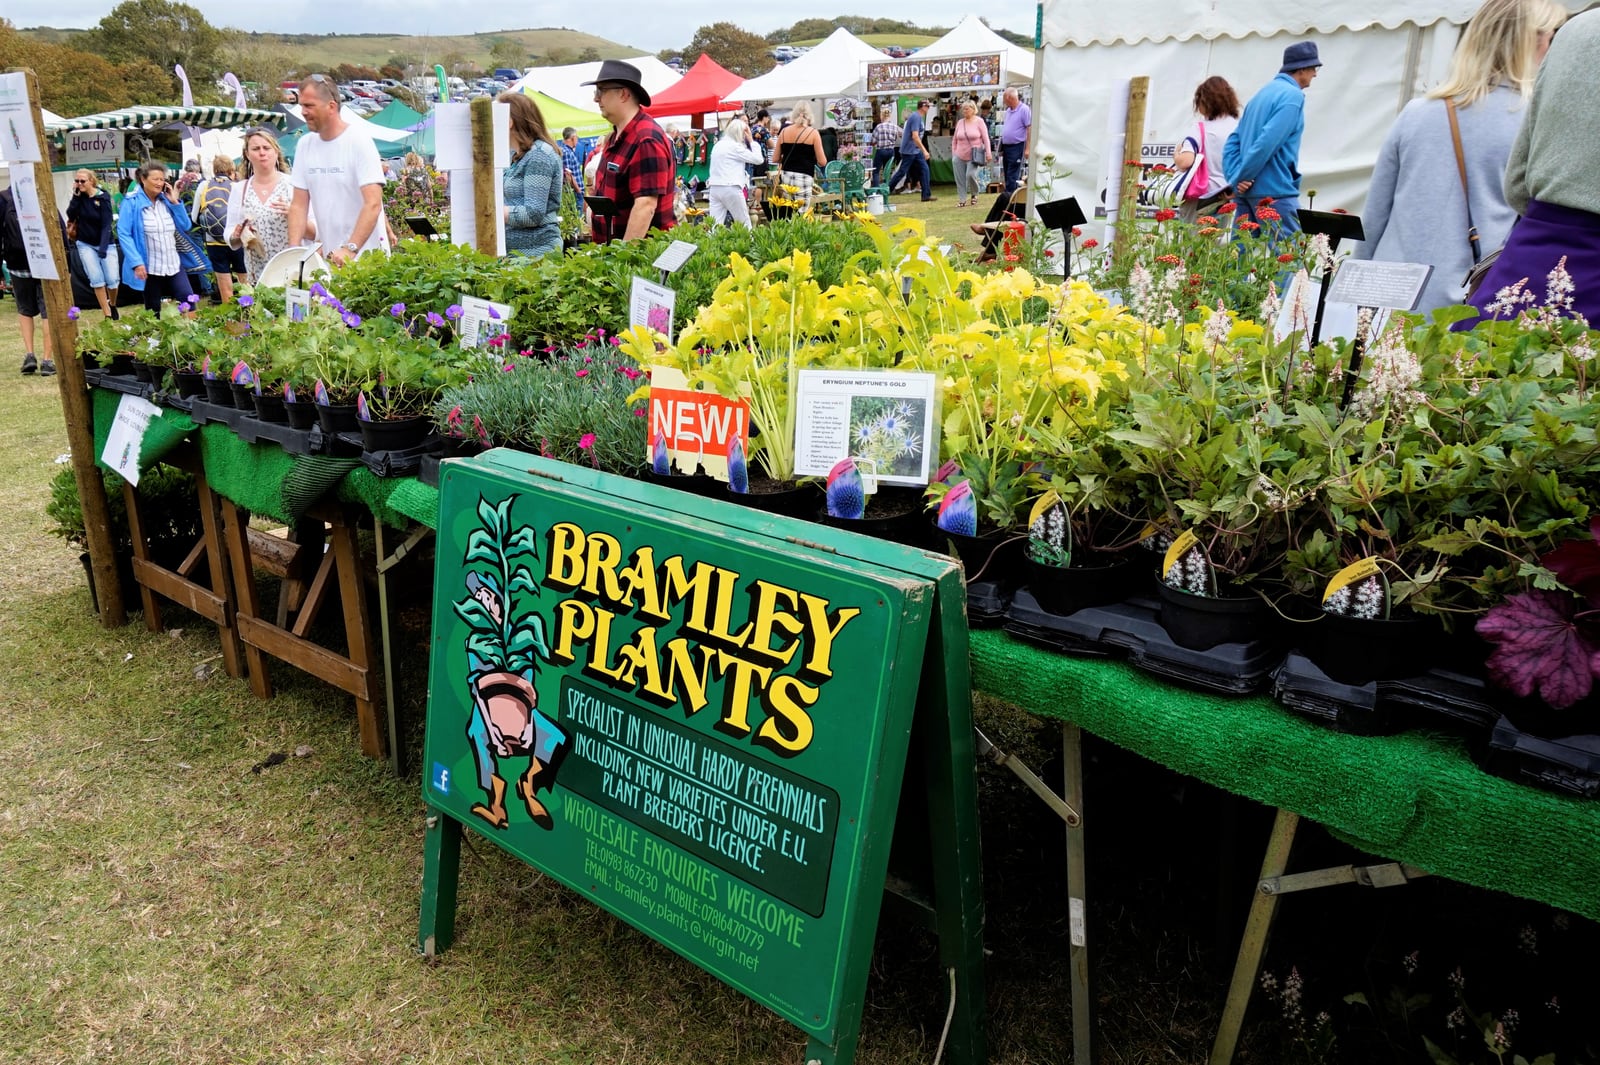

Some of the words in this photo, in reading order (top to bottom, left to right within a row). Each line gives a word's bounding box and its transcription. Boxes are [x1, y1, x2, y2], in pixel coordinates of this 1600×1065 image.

[888, 60, 978, 78] WILDFLOWERS
[653, 398, 744, 447] NEW!
[547, 523, 860, 677] BRAMLEY
[554, 602, 820, 753] PLANTS
[567, 688, 624, 741] SPECIALIST
[627, 714, 641, 749] IN
[643, 721, 697, 776] UNUSUAL
[700, 748, 743, 798] HARDY
[745, 767, 826, 834] PERENNIALS
[574, 732, 633, 778] INCLUDING
[636, 761, 665, 794] NEW
[668, 775, 727, 826] VARIETIES
[732, 808, 777, 850] UNDER
[781, 830, 808, 866] E.U.
[564, 796, 638, 859] WHOLESALE
[642, 837, 719, 903] ENQUIRIES
[726, 881, 805, 949] WELCOME
[584, 857, 613, 889] EMAIL:
[602, 771, 641, 810] PLANT
[643, 795, 704, 842] BREEDERS
[709, 824, 765, 874] LICENCE.
[623, 863, 659, 893] 867230
